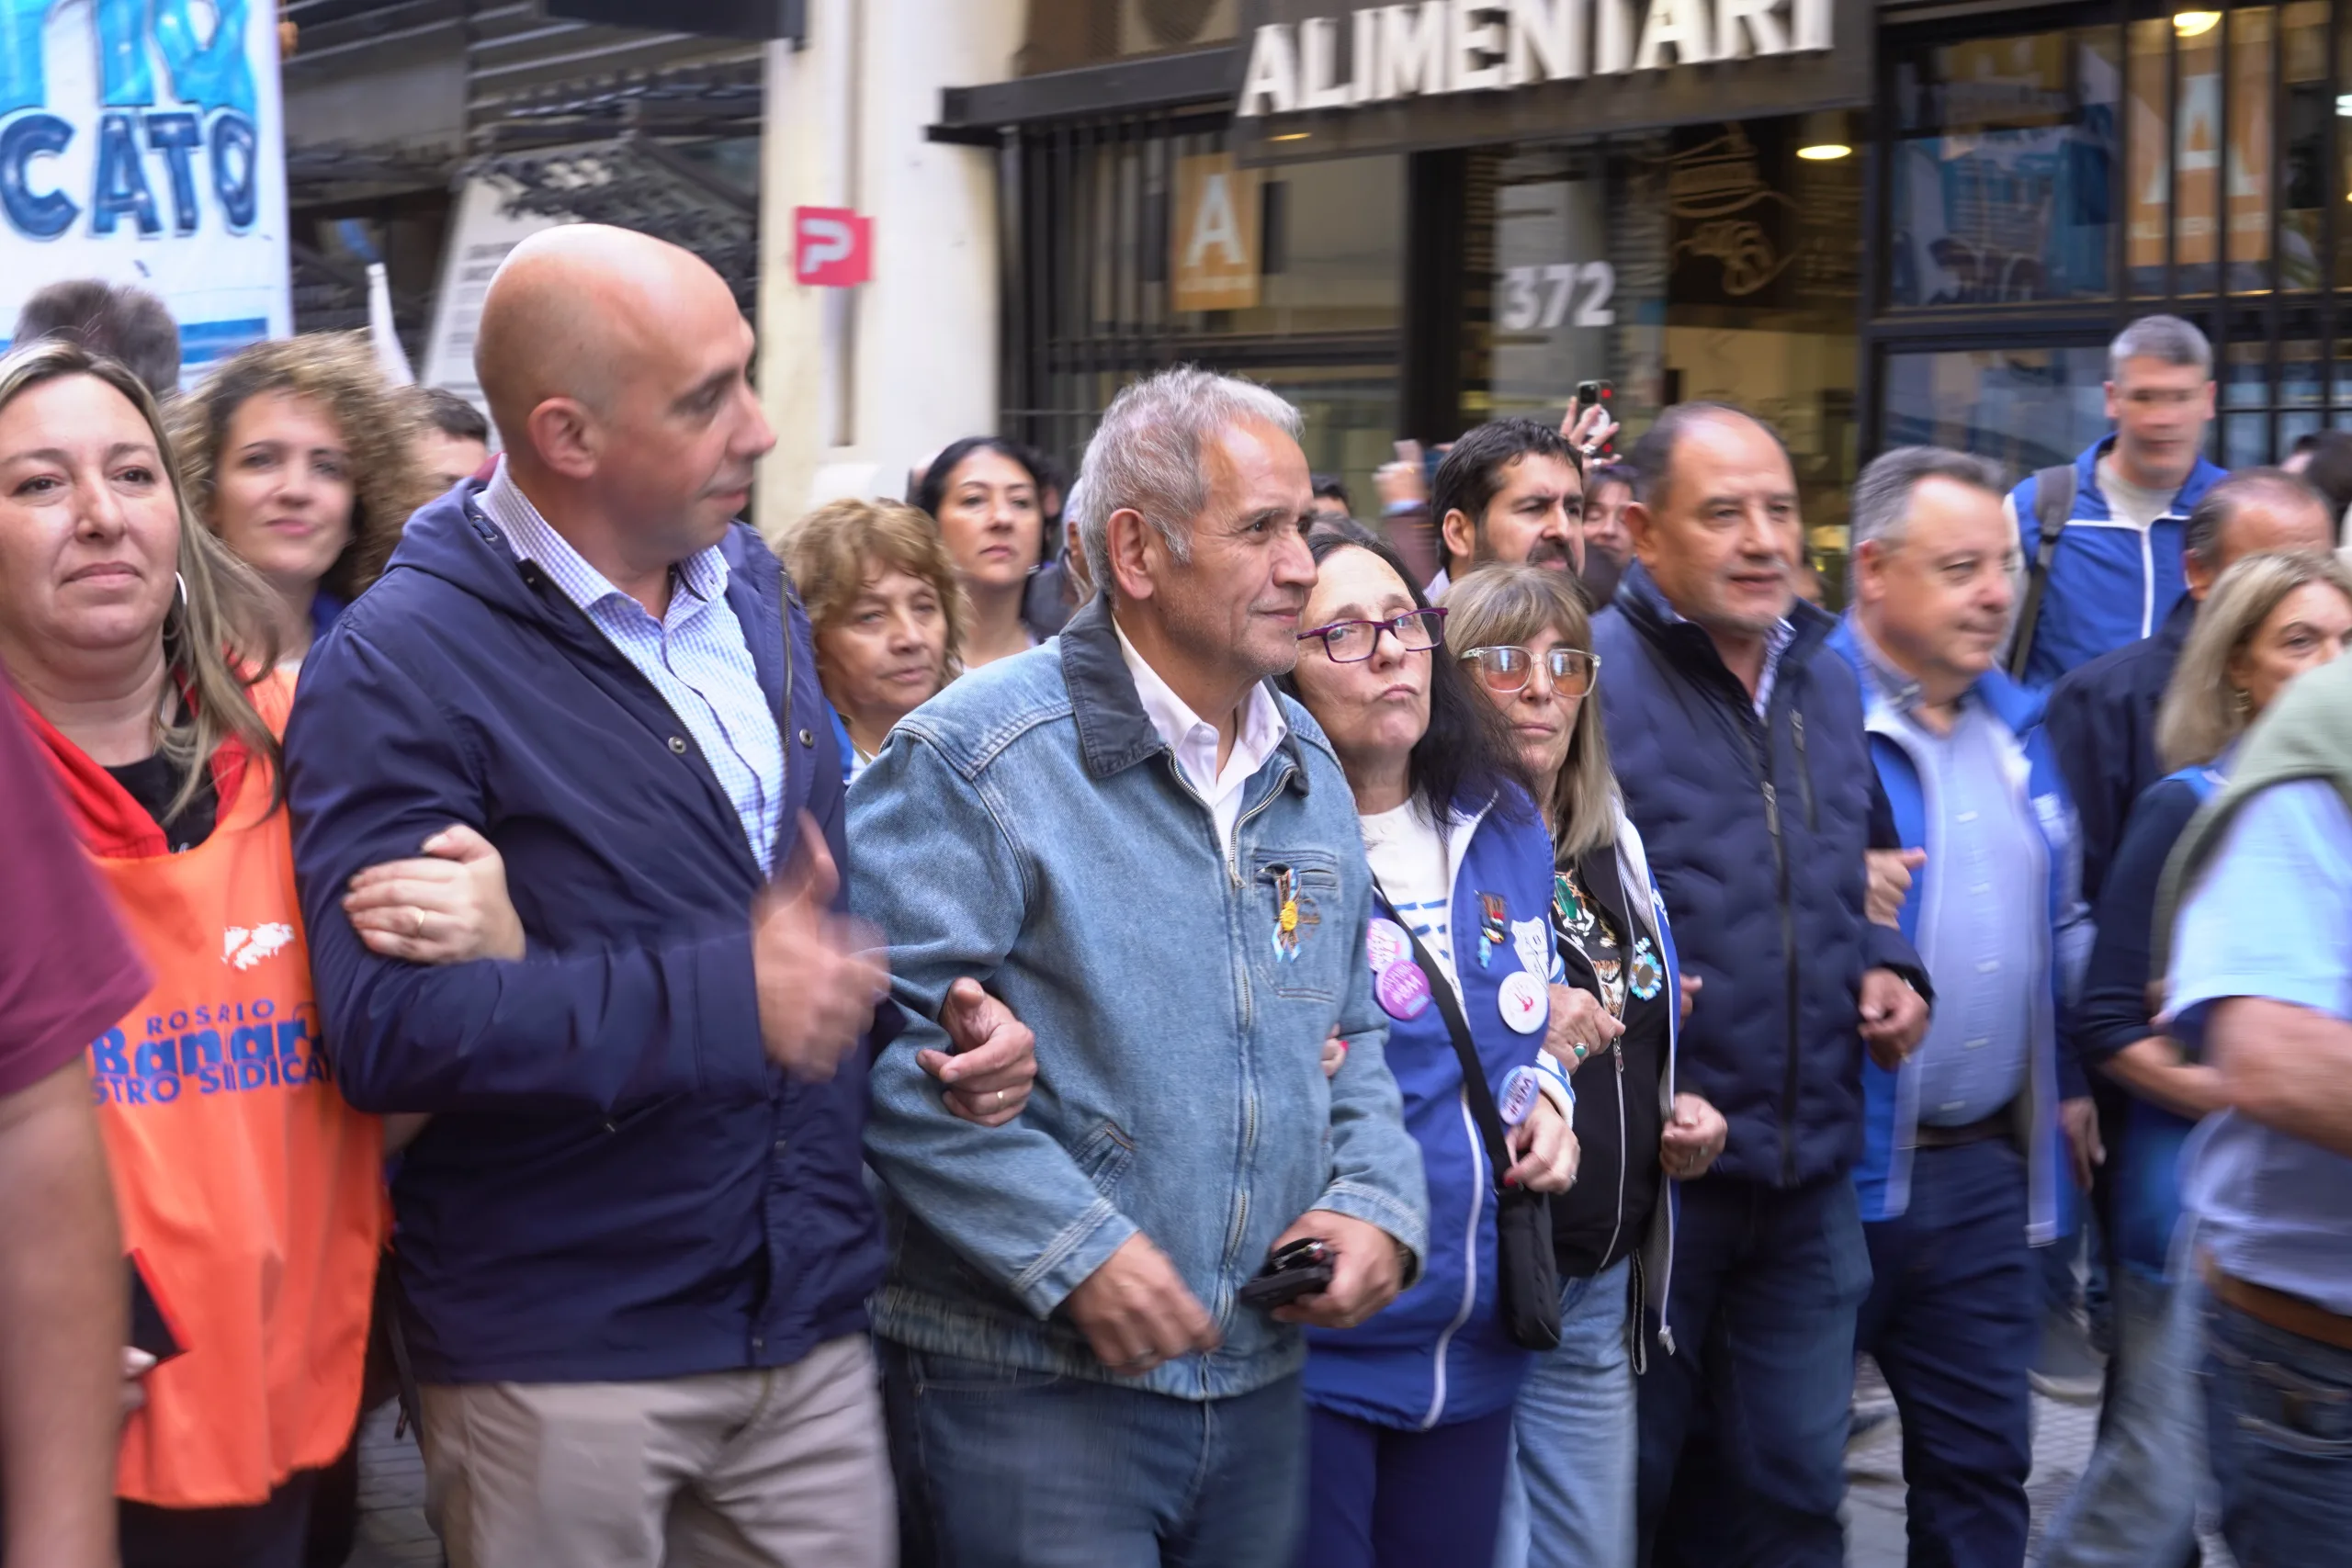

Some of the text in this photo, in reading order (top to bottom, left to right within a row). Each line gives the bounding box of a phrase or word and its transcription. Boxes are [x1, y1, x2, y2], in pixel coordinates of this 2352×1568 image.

[1237, 0, 1835, 117] ALIMENTARI
[0, 109, 258, 239] CATO
[1184, 173, 1250, 267] A
[1500, 261, 1615, 331] 372
